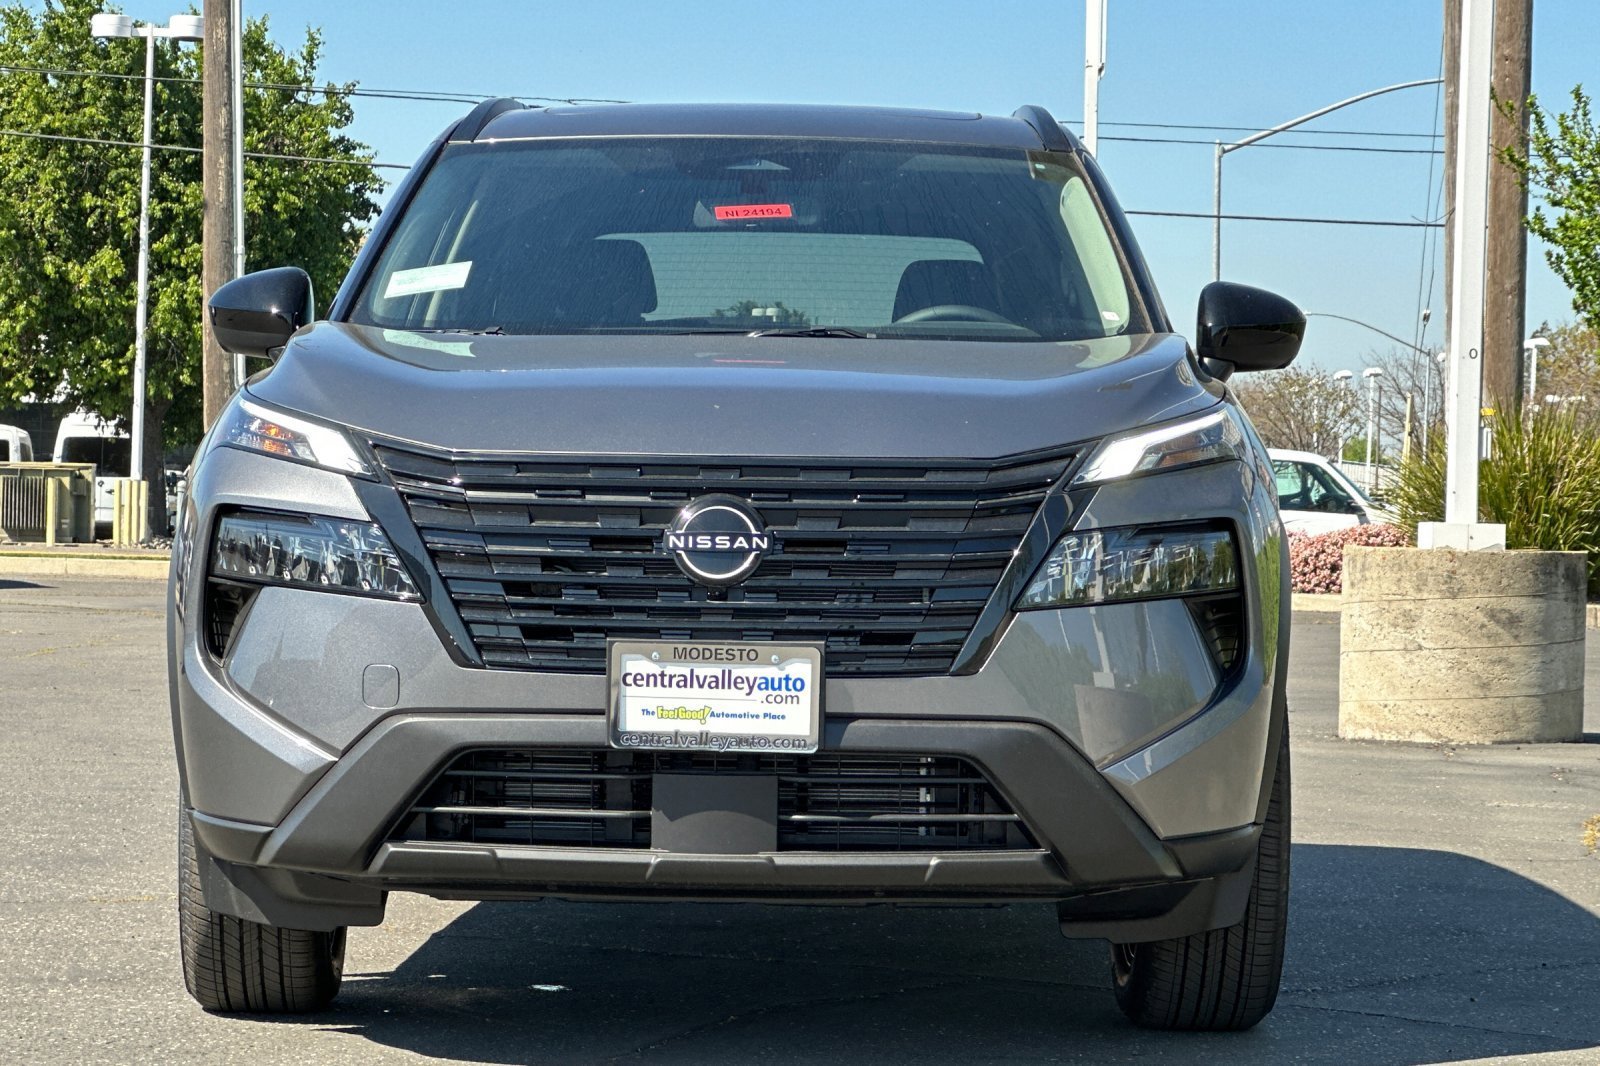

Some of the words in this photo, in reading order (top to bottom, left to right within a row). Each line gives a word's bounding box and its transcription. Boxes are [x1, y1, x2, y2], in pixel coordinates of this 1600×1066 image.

[668, 535, 768, 549] NISSAN
[673, 647, 759, 661] MODESTO
[621, 669, 805, 696] centralvalleyauto
[760, 693, 800, 705] .com
[641, 709, 655, 717] The
[709, 712, 760, 720] Automotive
[763, 712, 786, 720] Place
[620, 730, 808, 752] centralvalleyauto.com
